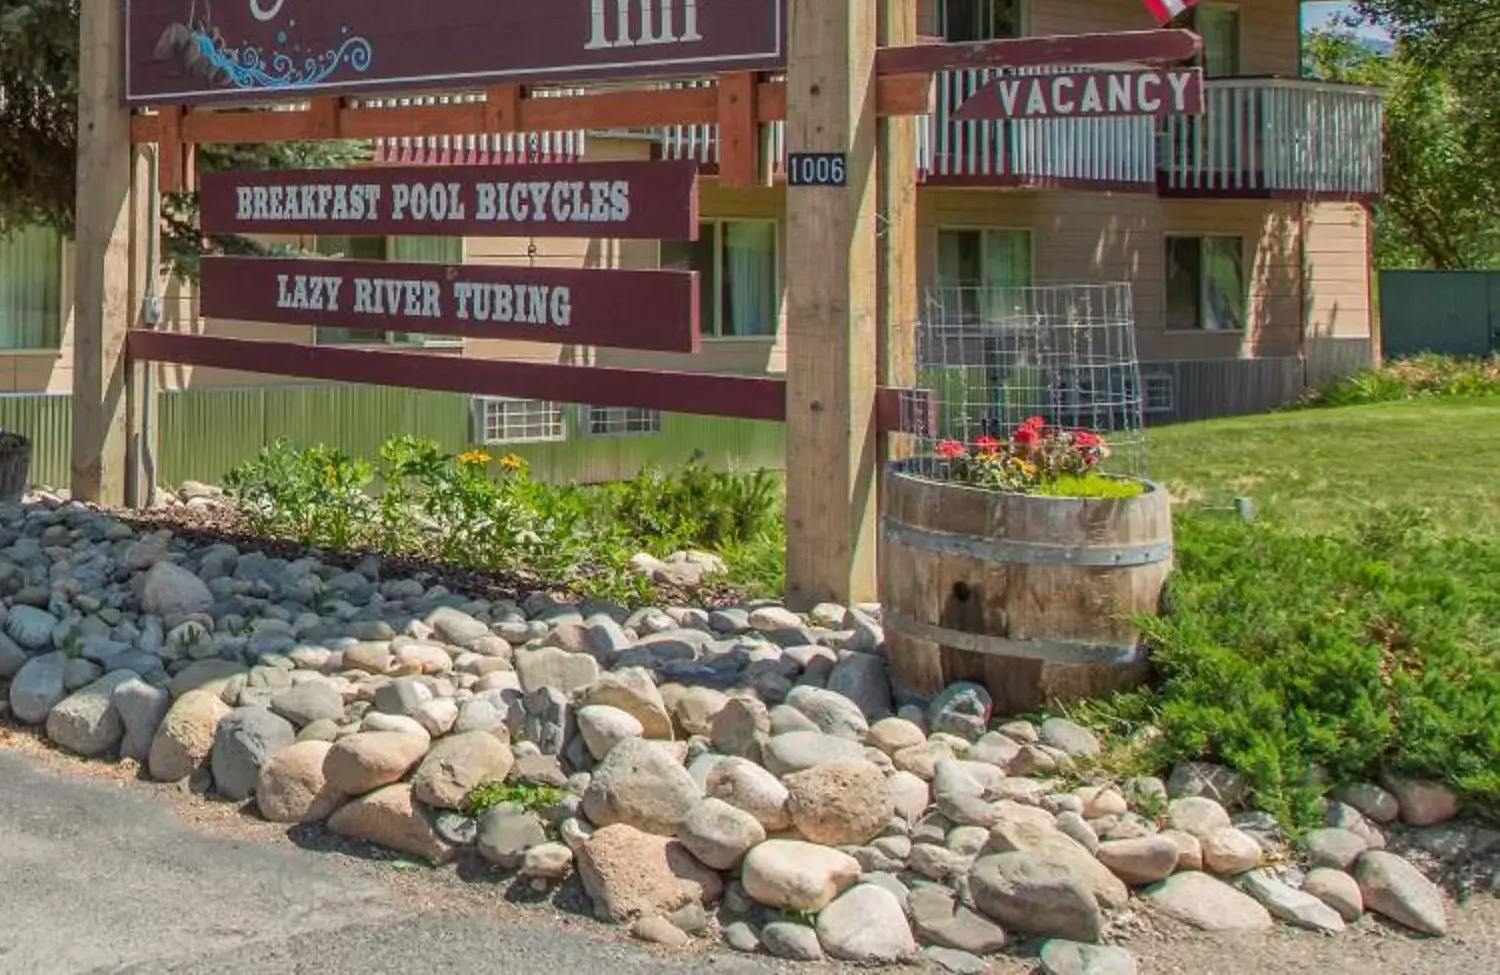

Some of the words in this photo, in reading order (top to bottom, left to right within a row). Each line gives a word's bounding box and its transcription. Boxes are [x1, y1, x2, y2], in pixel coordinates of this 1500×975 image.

[1000, 72, 1191, 115] VACANCY
[790, 156, 844, 184] 1006
[236, 184, 380, 220] BREAKFAST
[392, 182, 465, 220] POOL
[475, 180, 630, 223] BICYCLES
[277, 274, 343, 310] LAZY
[354, 279, 441, 318] RIVER
[454, 283, 573, 326] TUBING
